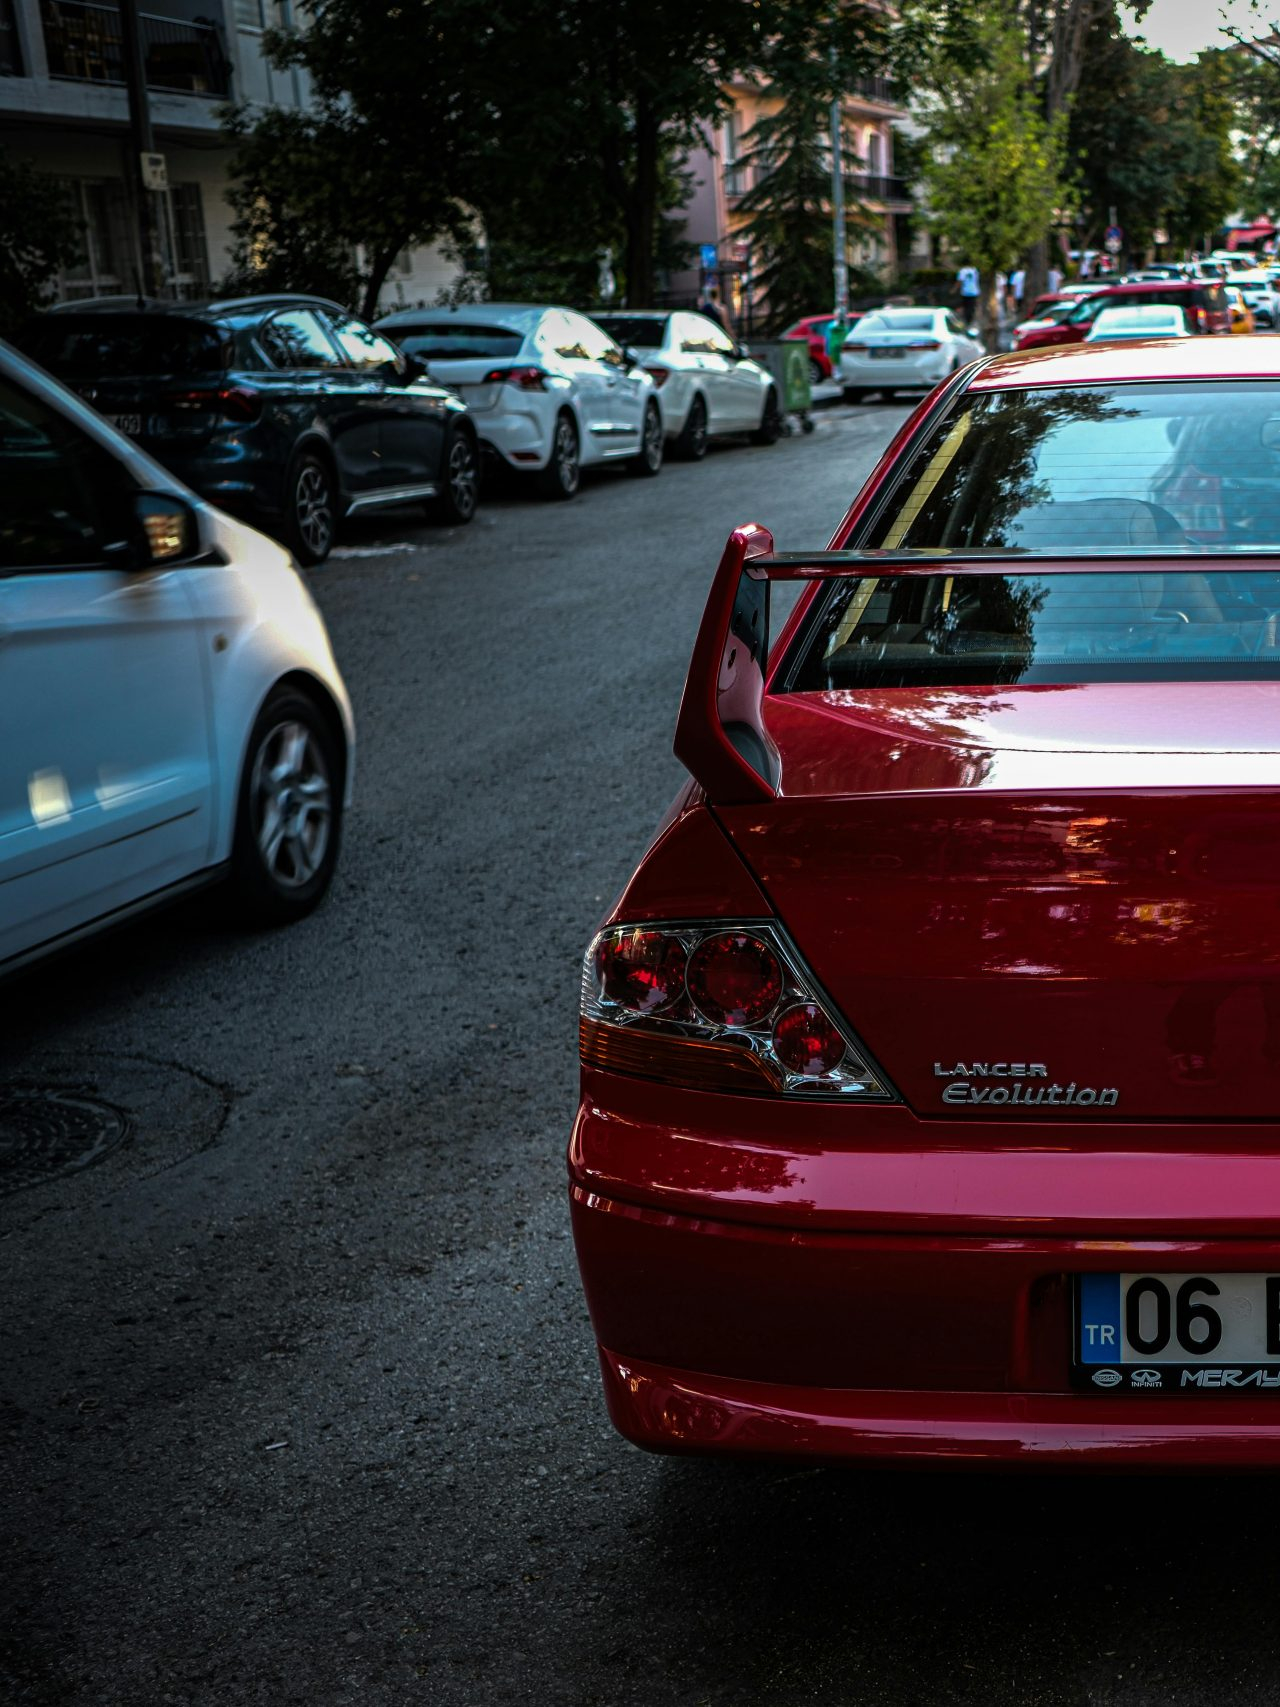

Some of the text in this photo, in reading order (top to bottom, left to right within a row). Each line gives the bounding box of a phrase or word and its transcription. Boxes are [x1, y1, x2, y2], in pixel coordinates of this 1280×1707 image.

[933, 1062, 1048, 1078] LANCER
[941, 1082, 1119, 1106] Evolution
[1125, 1276, 1222, 1355] 06
[1085, 1325, 1115, 1345] TR
